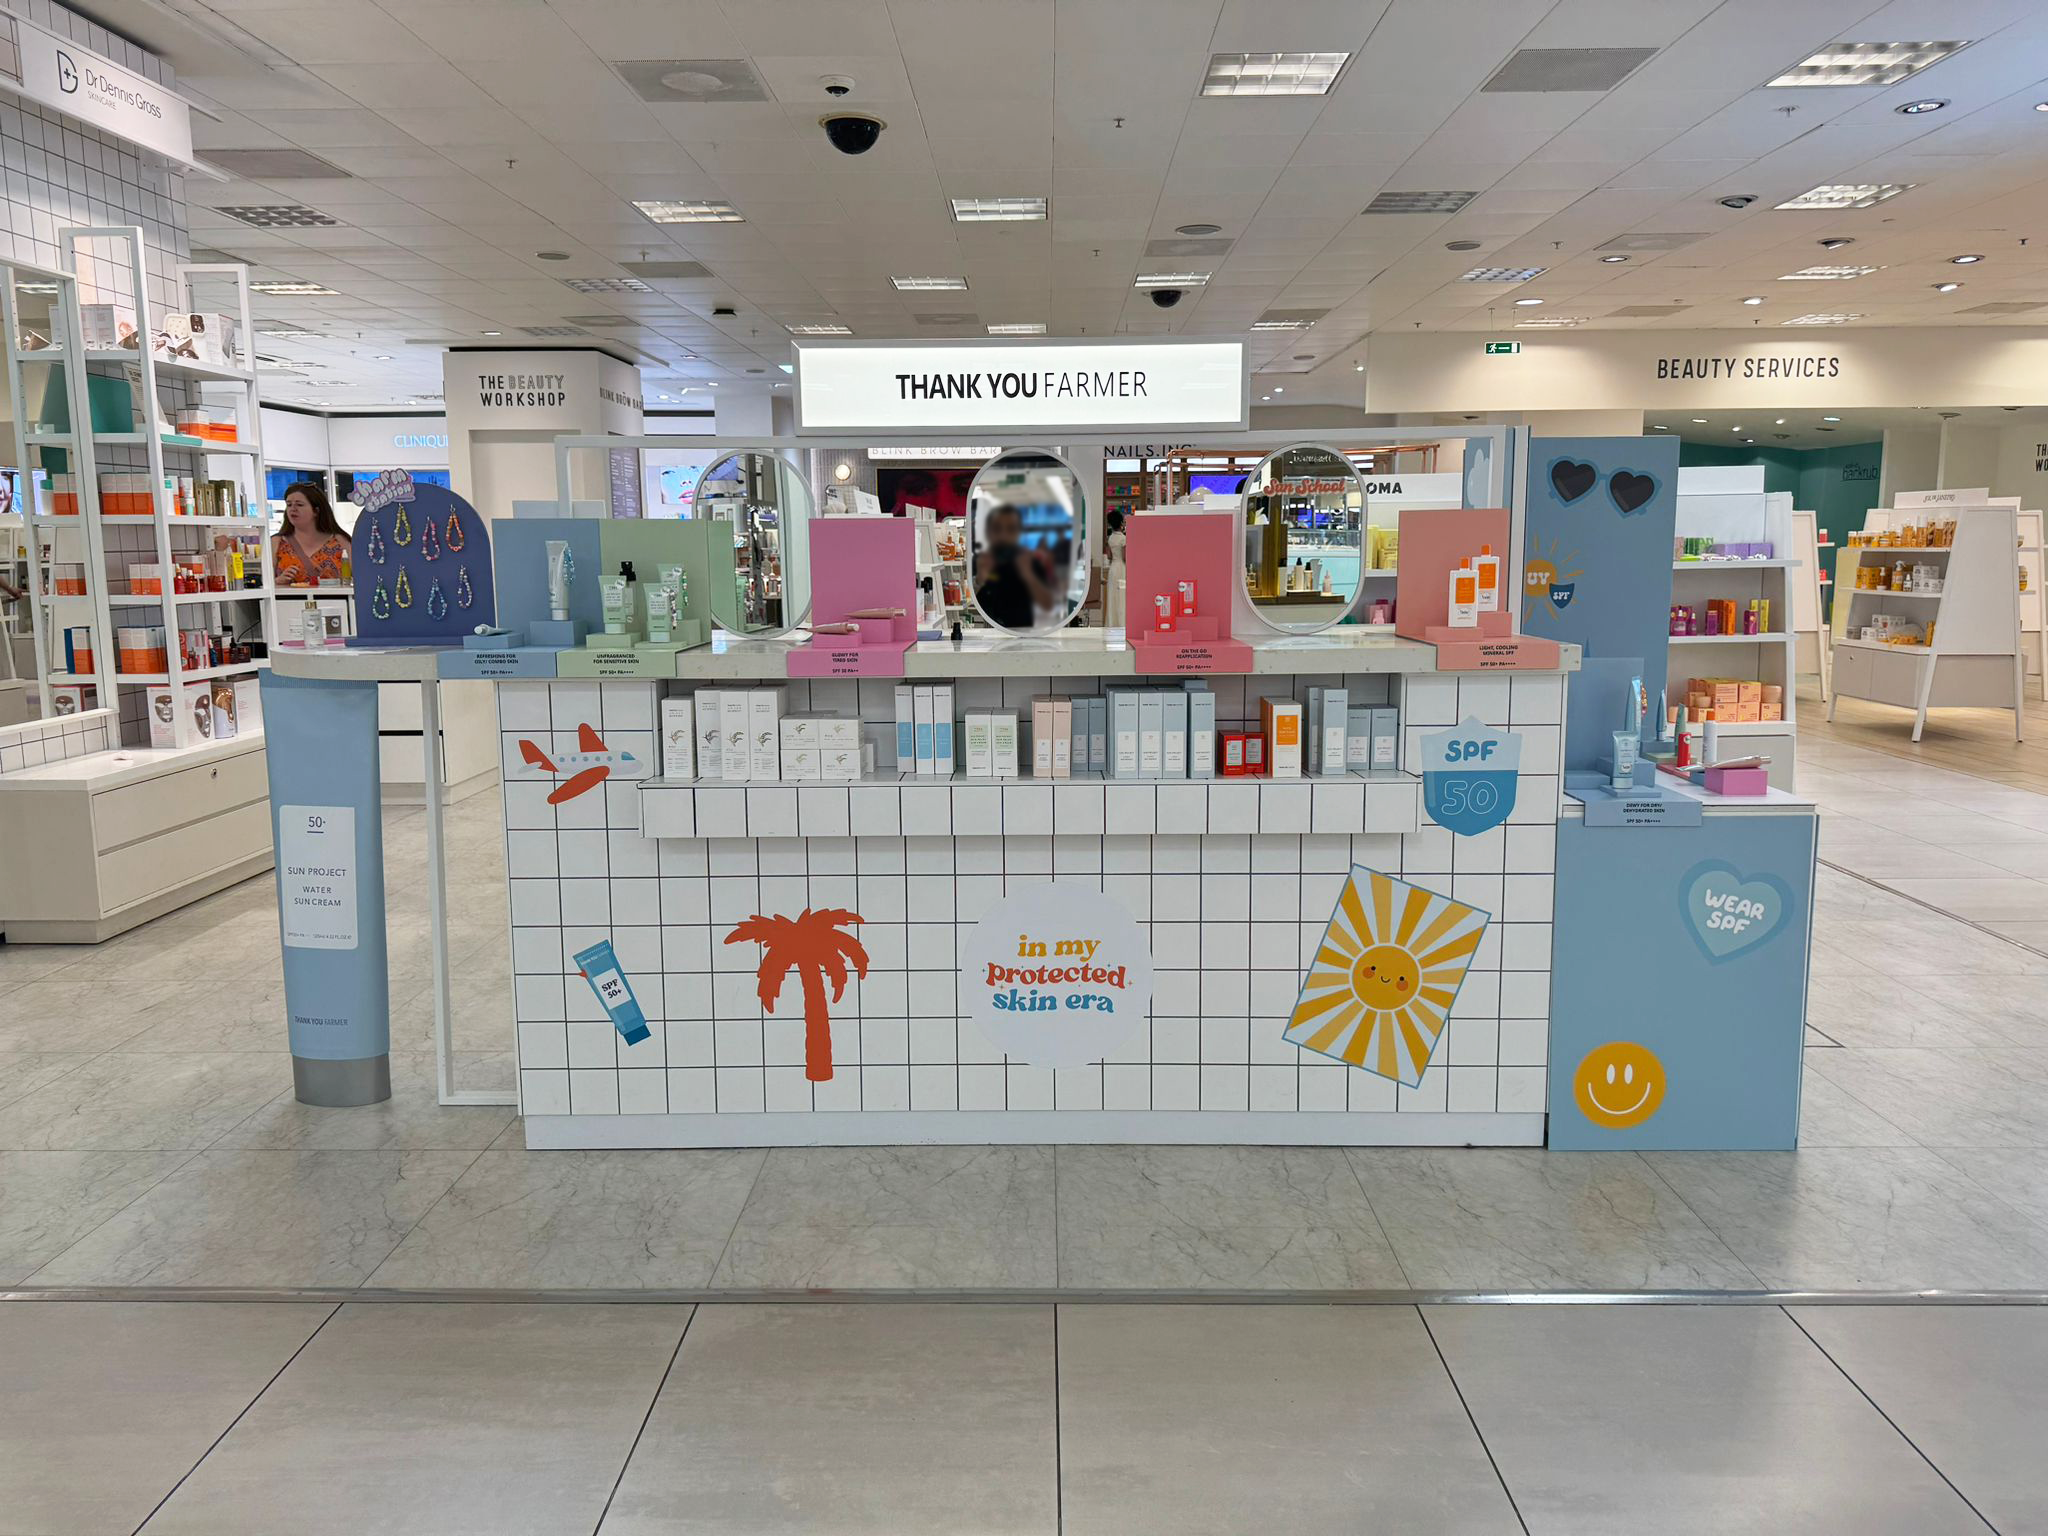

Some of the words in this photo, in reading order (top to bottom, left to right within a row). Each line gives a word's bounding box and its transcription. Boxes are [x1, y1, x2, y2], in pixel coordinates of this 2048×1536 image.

[86, 69, 98, 88] Dr
[100, 75, 135, 106] Dennis
[135, 93, 161, 119] Gross
[1657, 359, 1736, 379] BEAUTY
[1743, 357, 1839, 378] SERVICES
[479, 375, 504, 390] THE
[508, 375, 565, 390] BEAUTY
[895, 373, 982, 399] THANK
[986, 372, 1037, 399] YOU
[1044, 371, 1148, 398] FARMER
[480, 392, 566, 407] WORKSHOP
[393, 434, 448, 449] CLINIQU
[872, 447, 912, 455] BLINK
[920, 447, 961, 455] BROW
[970, 446, 997, 455] BAR
[1264, 478, 1294, 496] Sun
[1295, 477, 1345, 496] School
[1527, 572, 1551, 585] UV
[1553, 591, 1570, 600] SPF
[1445, 739, 1498, 763] SPF
[1441, 780, 1498, 815] 50
[287, 866, 305, 875] SUN
[308, 867, 346, 877] PROJECT
[294, 897, 310, 905] SUN
[311, 898, 341, 906] CREAM
[1705, 888, 1765, 920] WEAR
[1706, 911, 1750, 934] SPF
[1017, 934, 1047, 957] in
[1054, 939, 1101, 962] my
[985, 962, 1126, 989] protected
[601, 979, 619, 992] SPF
[607, 988, 623, 999] 50+
[992, 989, 1058, 1012] skin
[1065, 993, 1114, 1013] era
[294, 1016, 311, 1024] THANK
